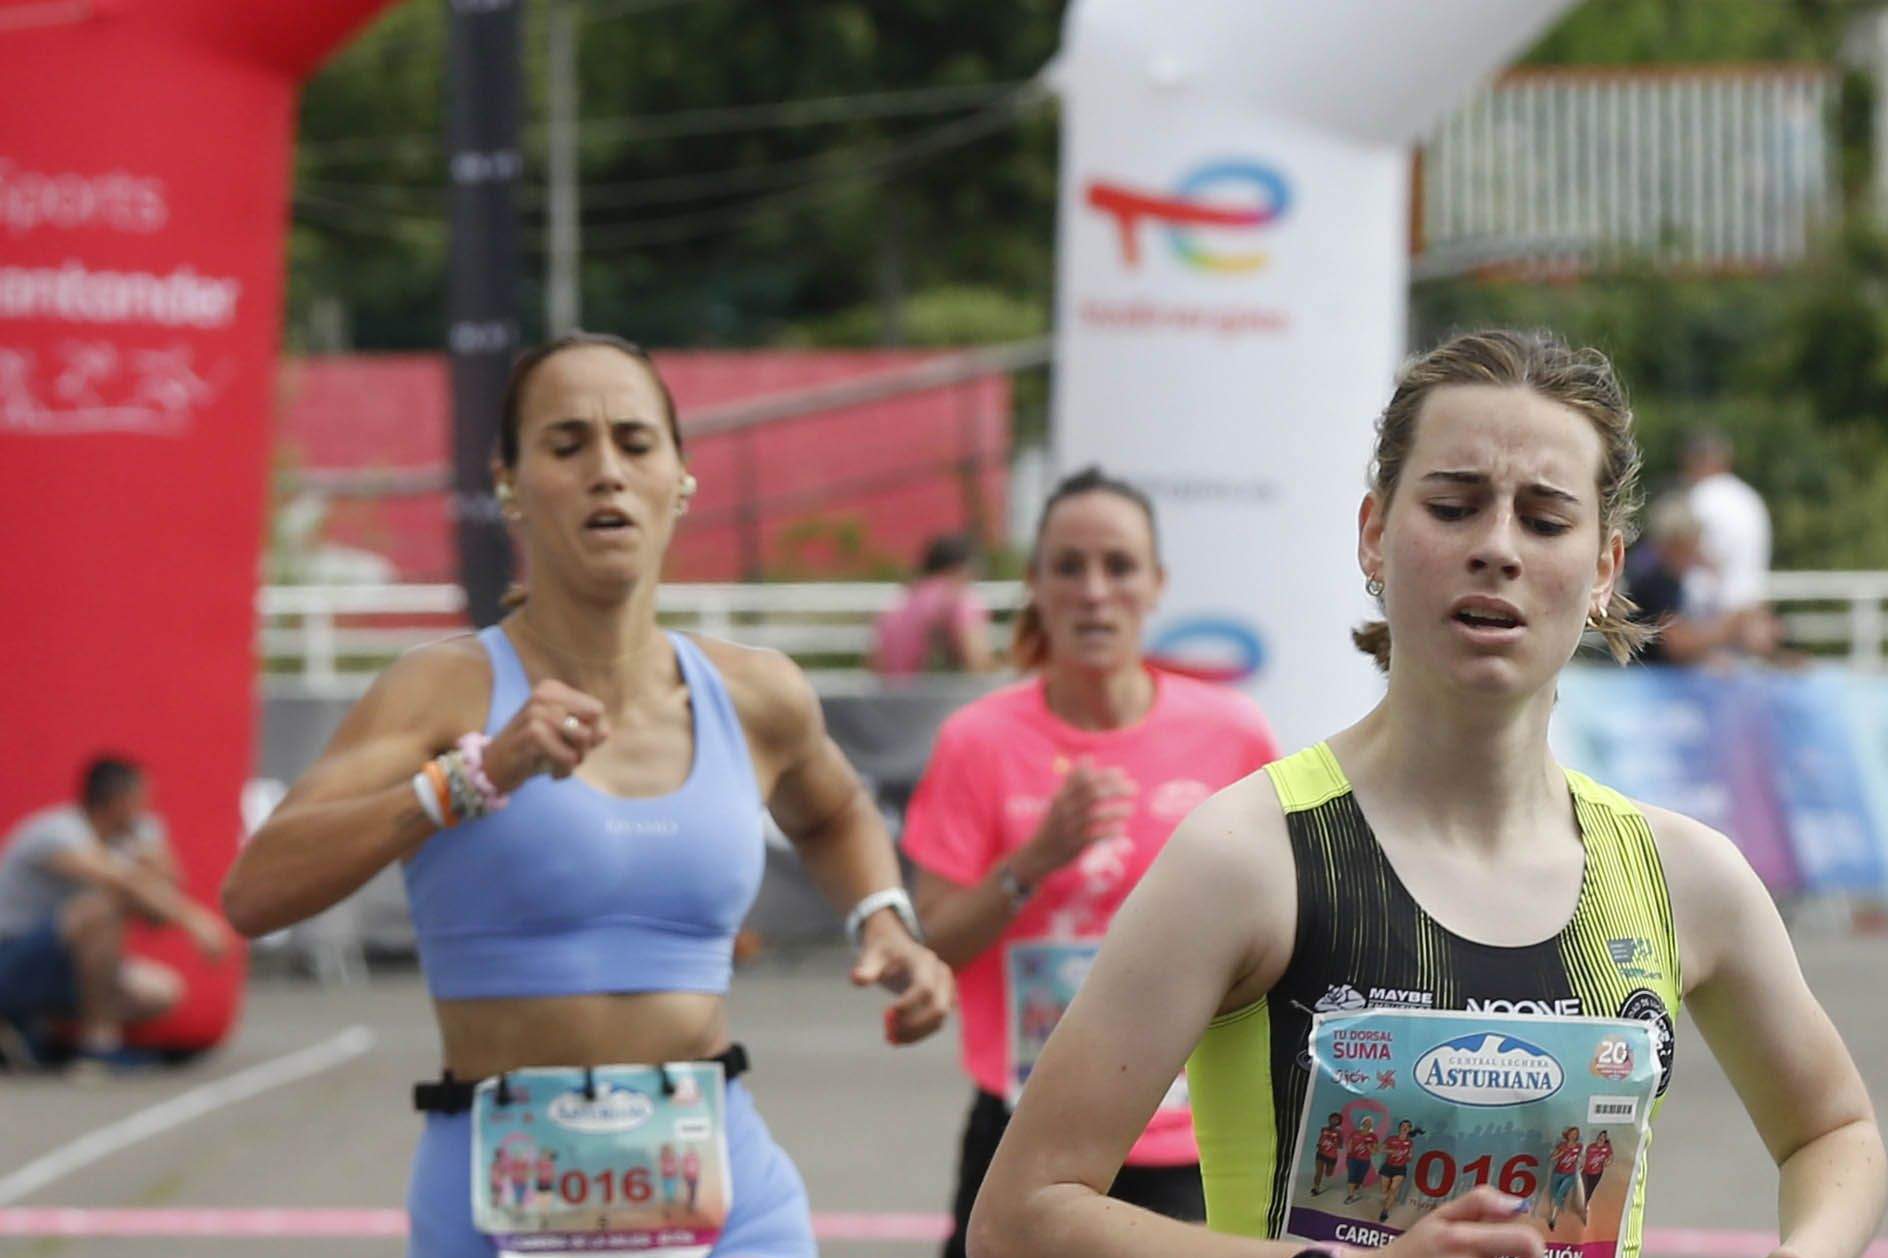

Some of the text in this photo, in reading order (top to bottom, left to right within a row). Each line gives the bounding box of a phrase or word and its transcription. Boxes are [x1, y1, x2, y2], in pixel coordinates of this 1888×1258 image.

[1369, 988, 1433, 1003] MAYBE
[1350, 1031, 1393, 1042] DORSAL
[1333, 1042, 1391, 1060] SUMA
[1599, 1041, 1628, 1064] 20
[1424, 1057, 1553, 1090] ASTURIANA
[559, 1167, 654, 1204] 016
[1415, 1151, 1539, 1198] 016
[1335, 1223, 1398, 1248] CARRE
